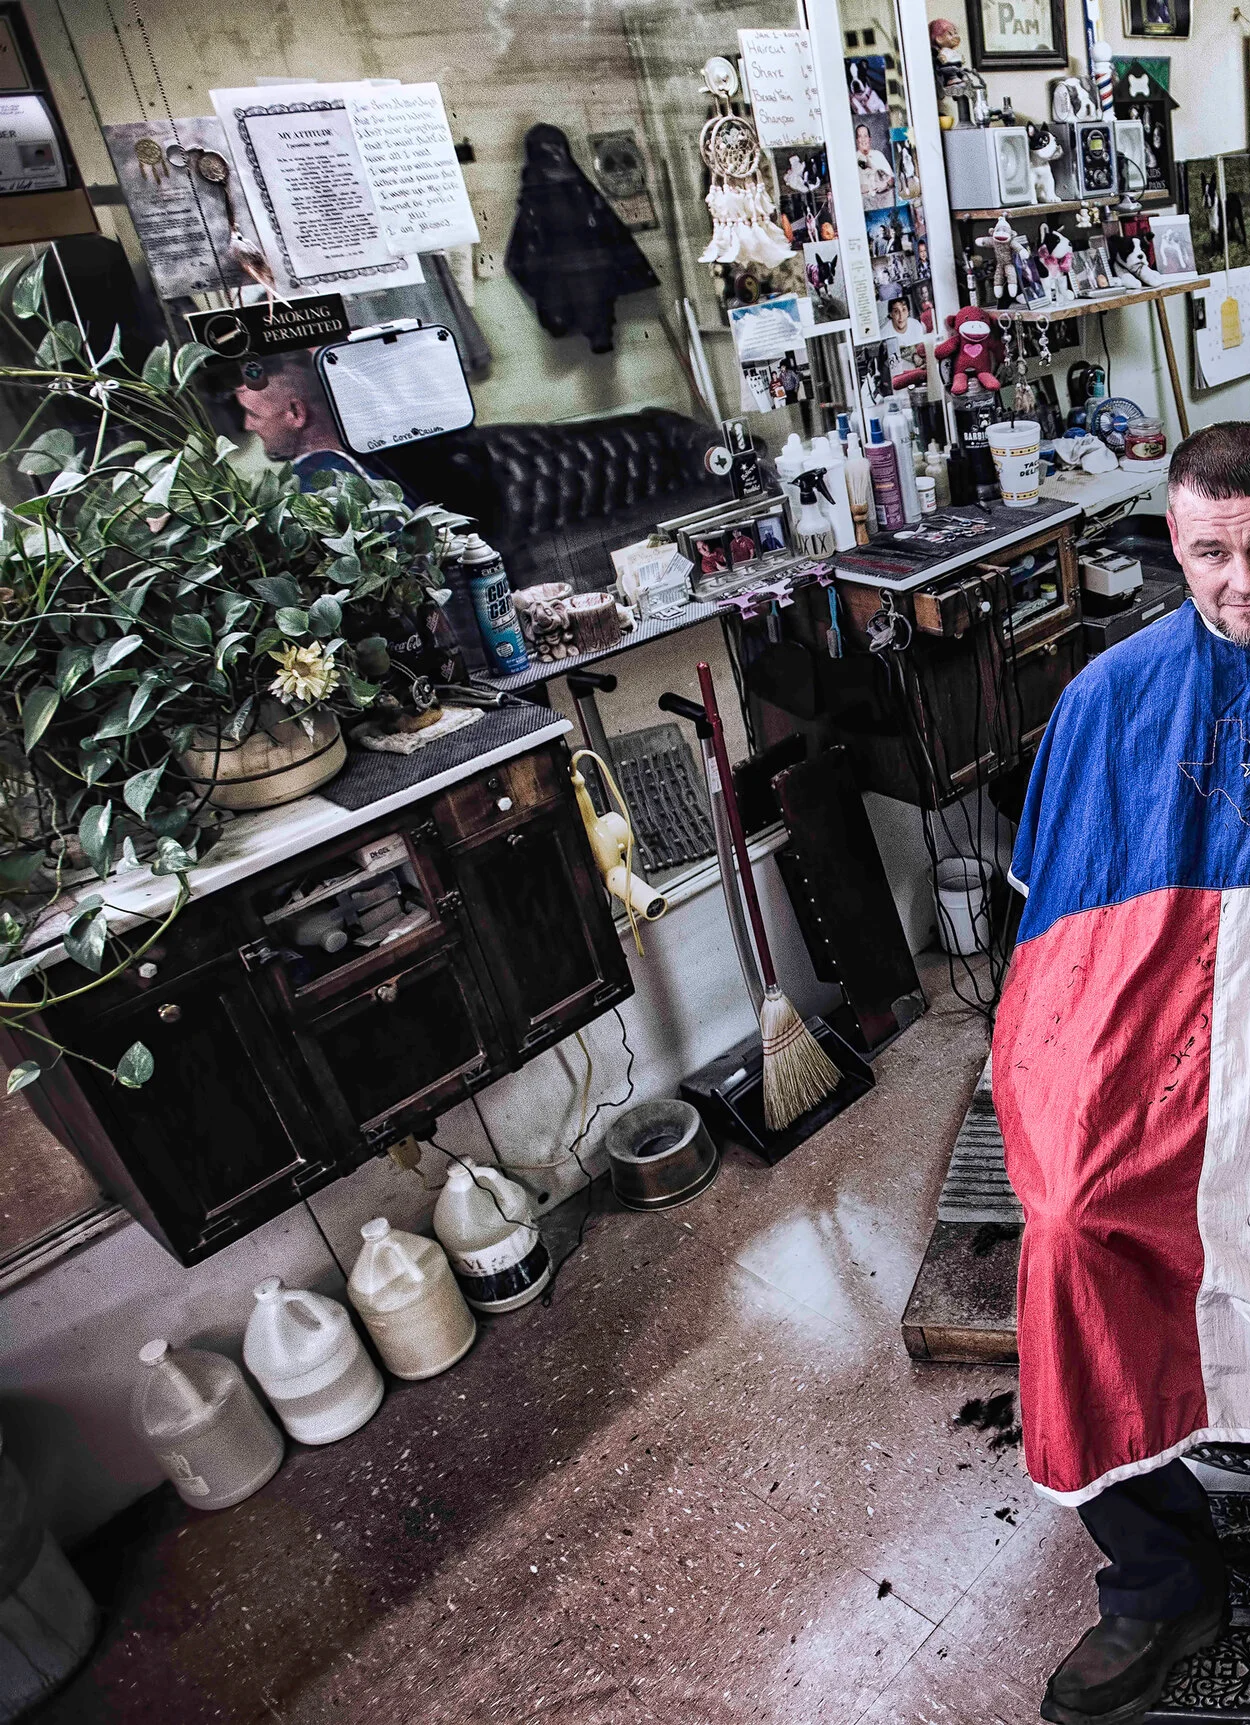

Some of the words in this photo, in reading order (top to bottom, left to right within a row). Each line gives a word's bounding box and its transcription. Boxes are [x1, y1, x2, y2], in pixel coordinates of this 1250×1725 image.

[998, 2, 1040, 35] PAM
[262, 304, 332, 328] SMOKING
[262, 317, 344, 344] PERMITTED
